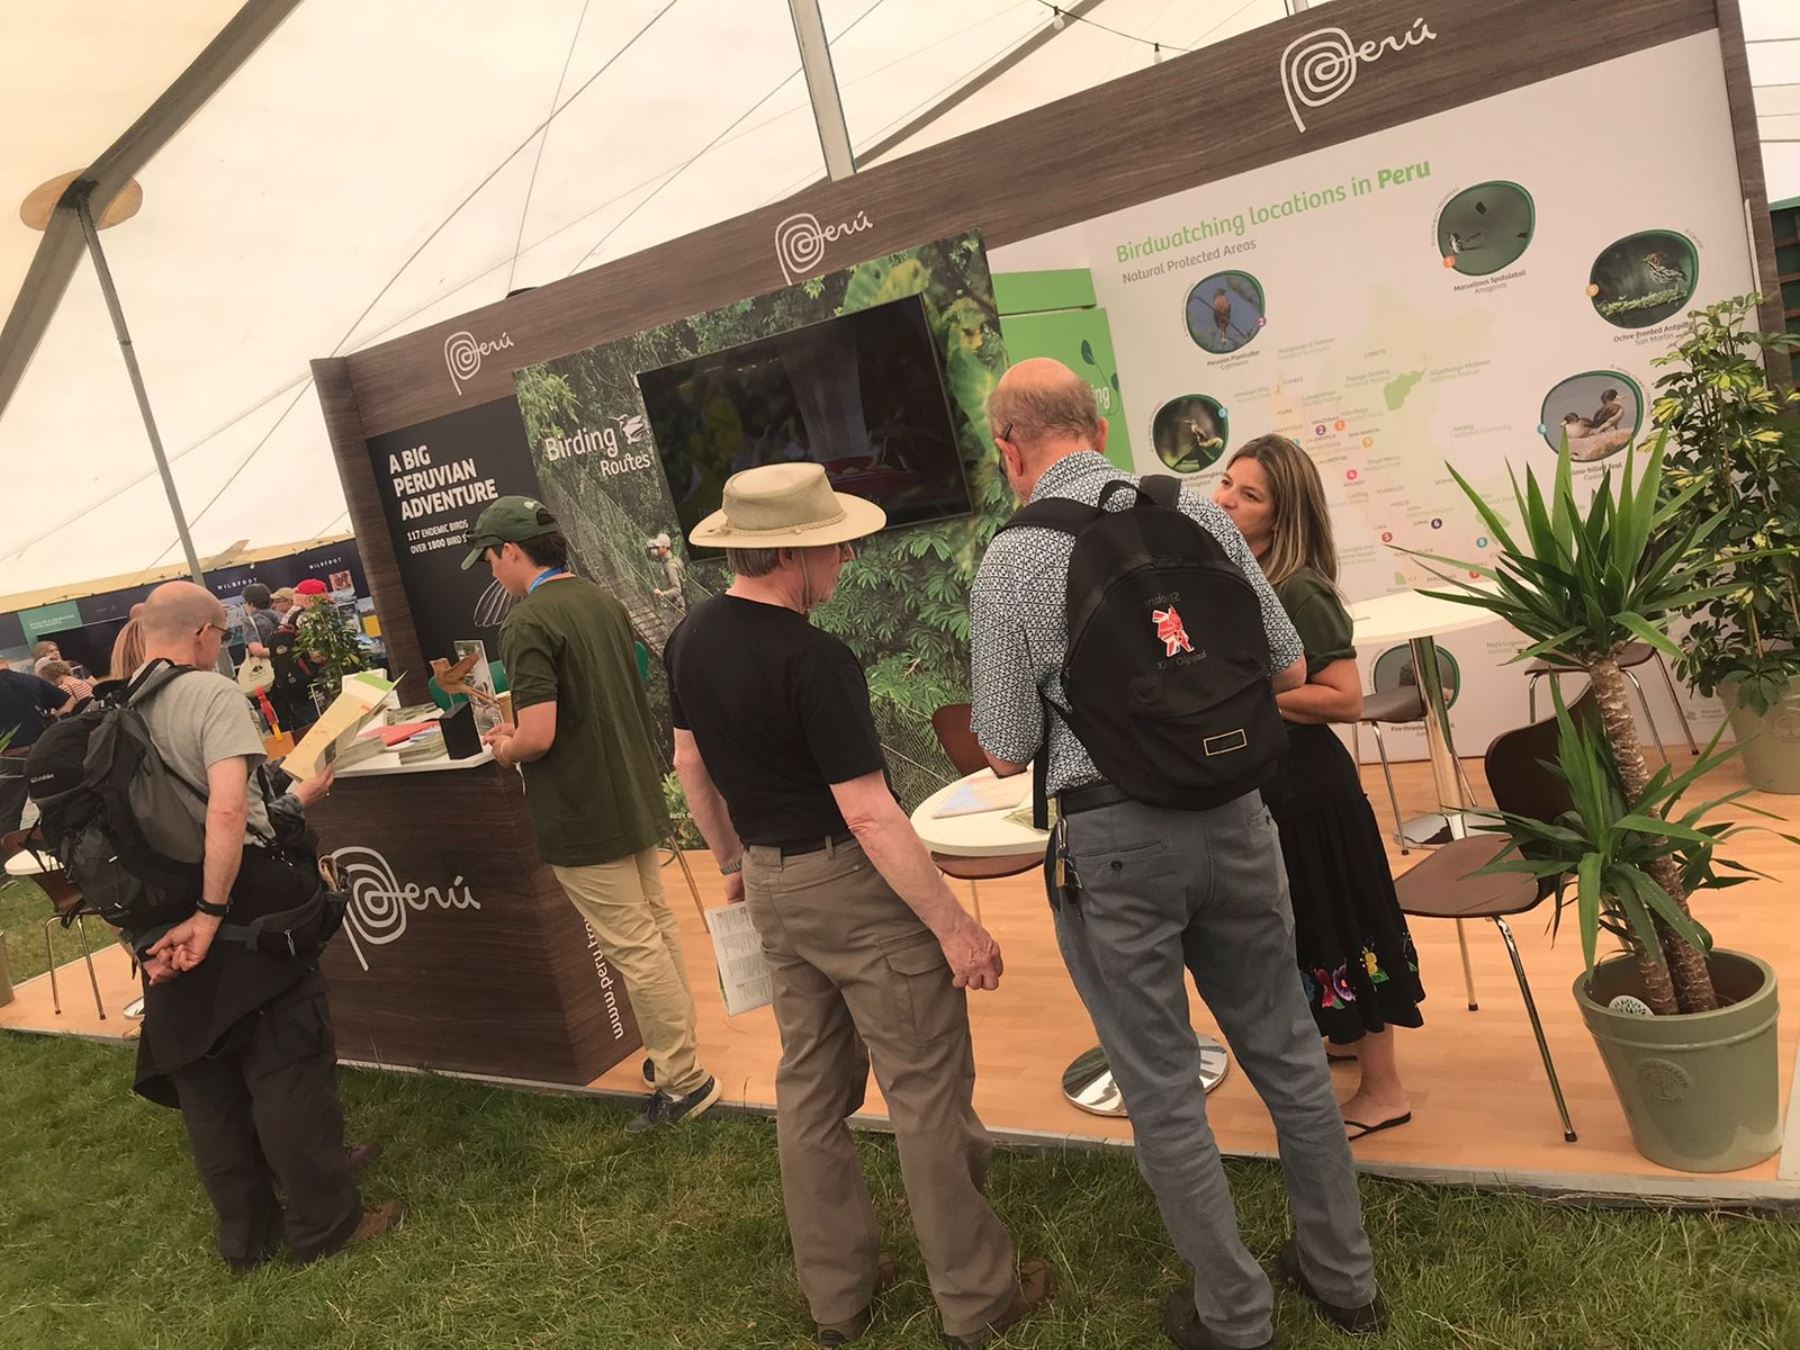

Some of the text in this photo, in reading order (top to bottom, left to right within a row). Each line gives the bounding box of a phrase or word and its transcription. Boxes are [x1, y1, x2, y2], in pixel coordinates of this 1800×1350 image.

[1280, 17, 1437, 133] Perú
[1116, 160, 1431, 263] Birdwatching locations in Peru
[775, 210, 873, 286] Perú
[1122, 239, 1257, 284] Natural Protected Areas
[444, 331, 514, 396] Perú
[389, 445, 431, 475] A BIG
[545, 426, 618, 462] Birding
[600, 452, 650, 478] Routes
[393, 458, 478, 497] PERUVIAN
[401, 478, 499, 521] ADVENTURE
[407, 519, 469, 541] 117 ENDEMIC BIRDS
[410, 541, 427, 554] OVER
[427, 538, 446, 551] 1800
[446, 534, 462, 548] BIRD
[332, 846, 481, 971] Perú
